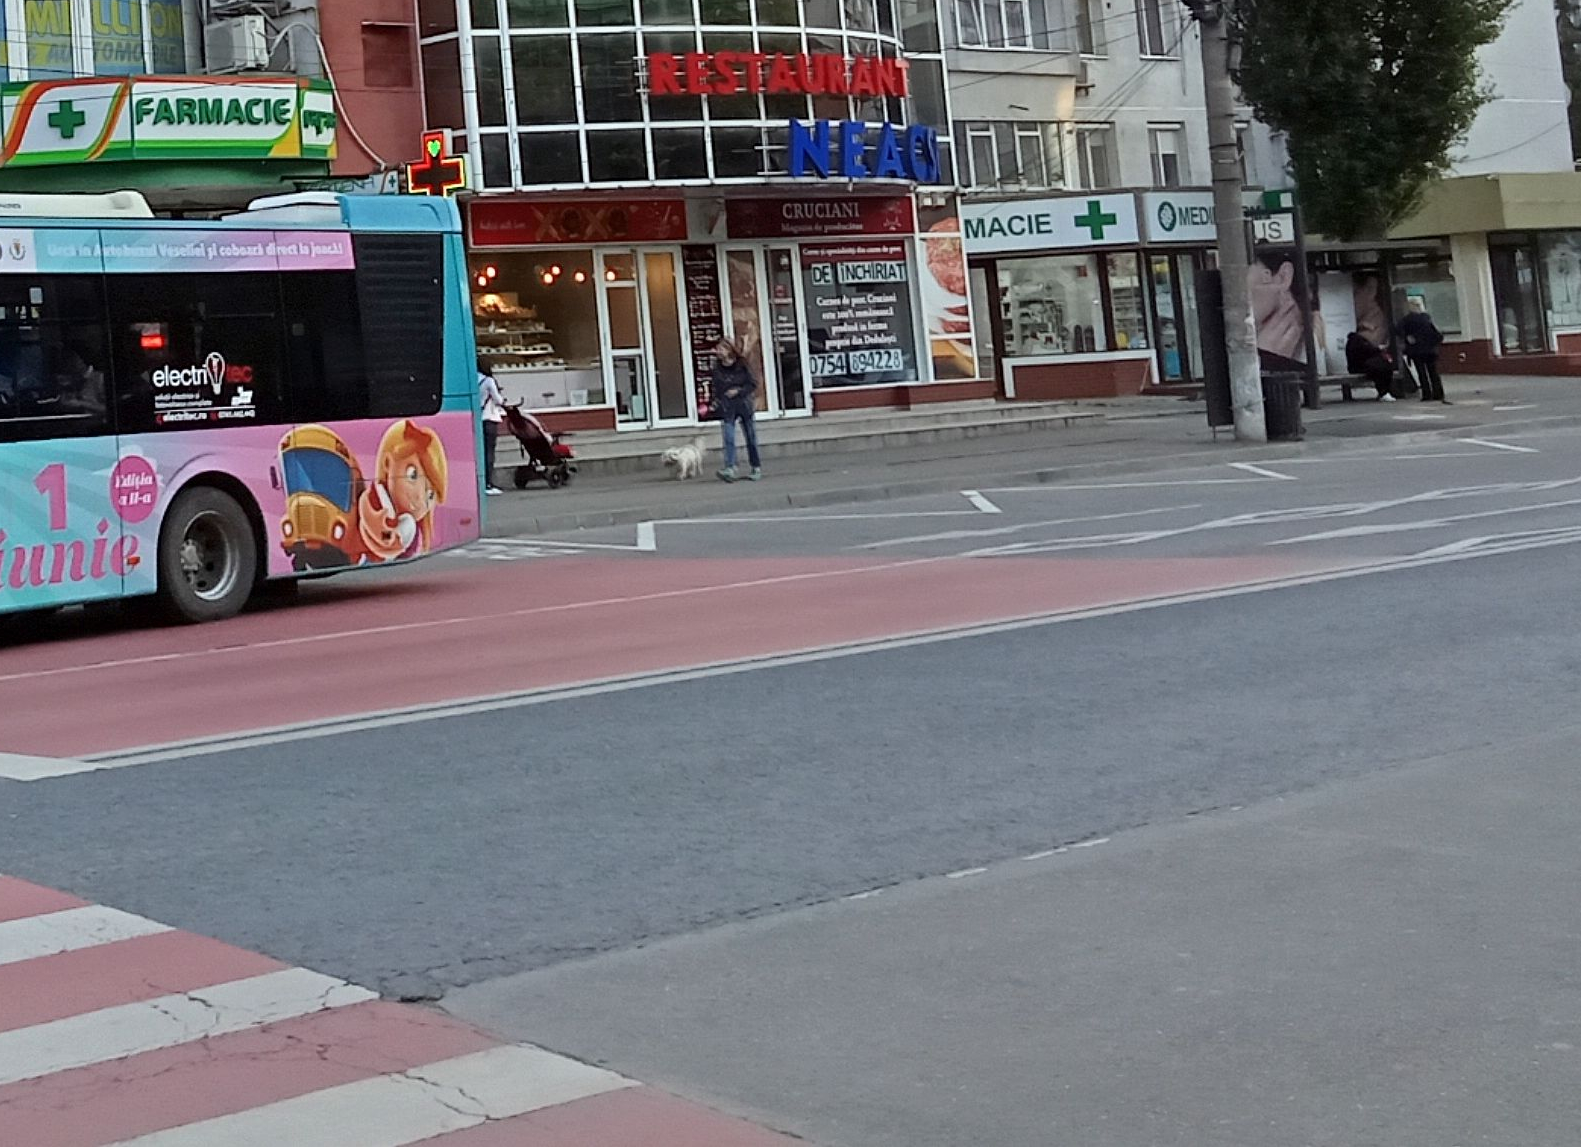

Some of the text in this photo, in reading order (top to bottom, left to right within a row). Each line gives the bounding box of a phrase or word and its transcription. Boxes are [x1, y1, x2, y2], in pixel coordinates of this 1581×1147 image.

[649, 51, 910, 98] RESTAURANT
[134, 96, 291, 126] FARMACIE
[782, 202, 860, 219] CRUCIANI
[963, 213, 1054, 240] MACIE
[813, 265, 831, 283] DE
[810, 354, 846, 374] 0754
[33, 463, 68, 531] 1
